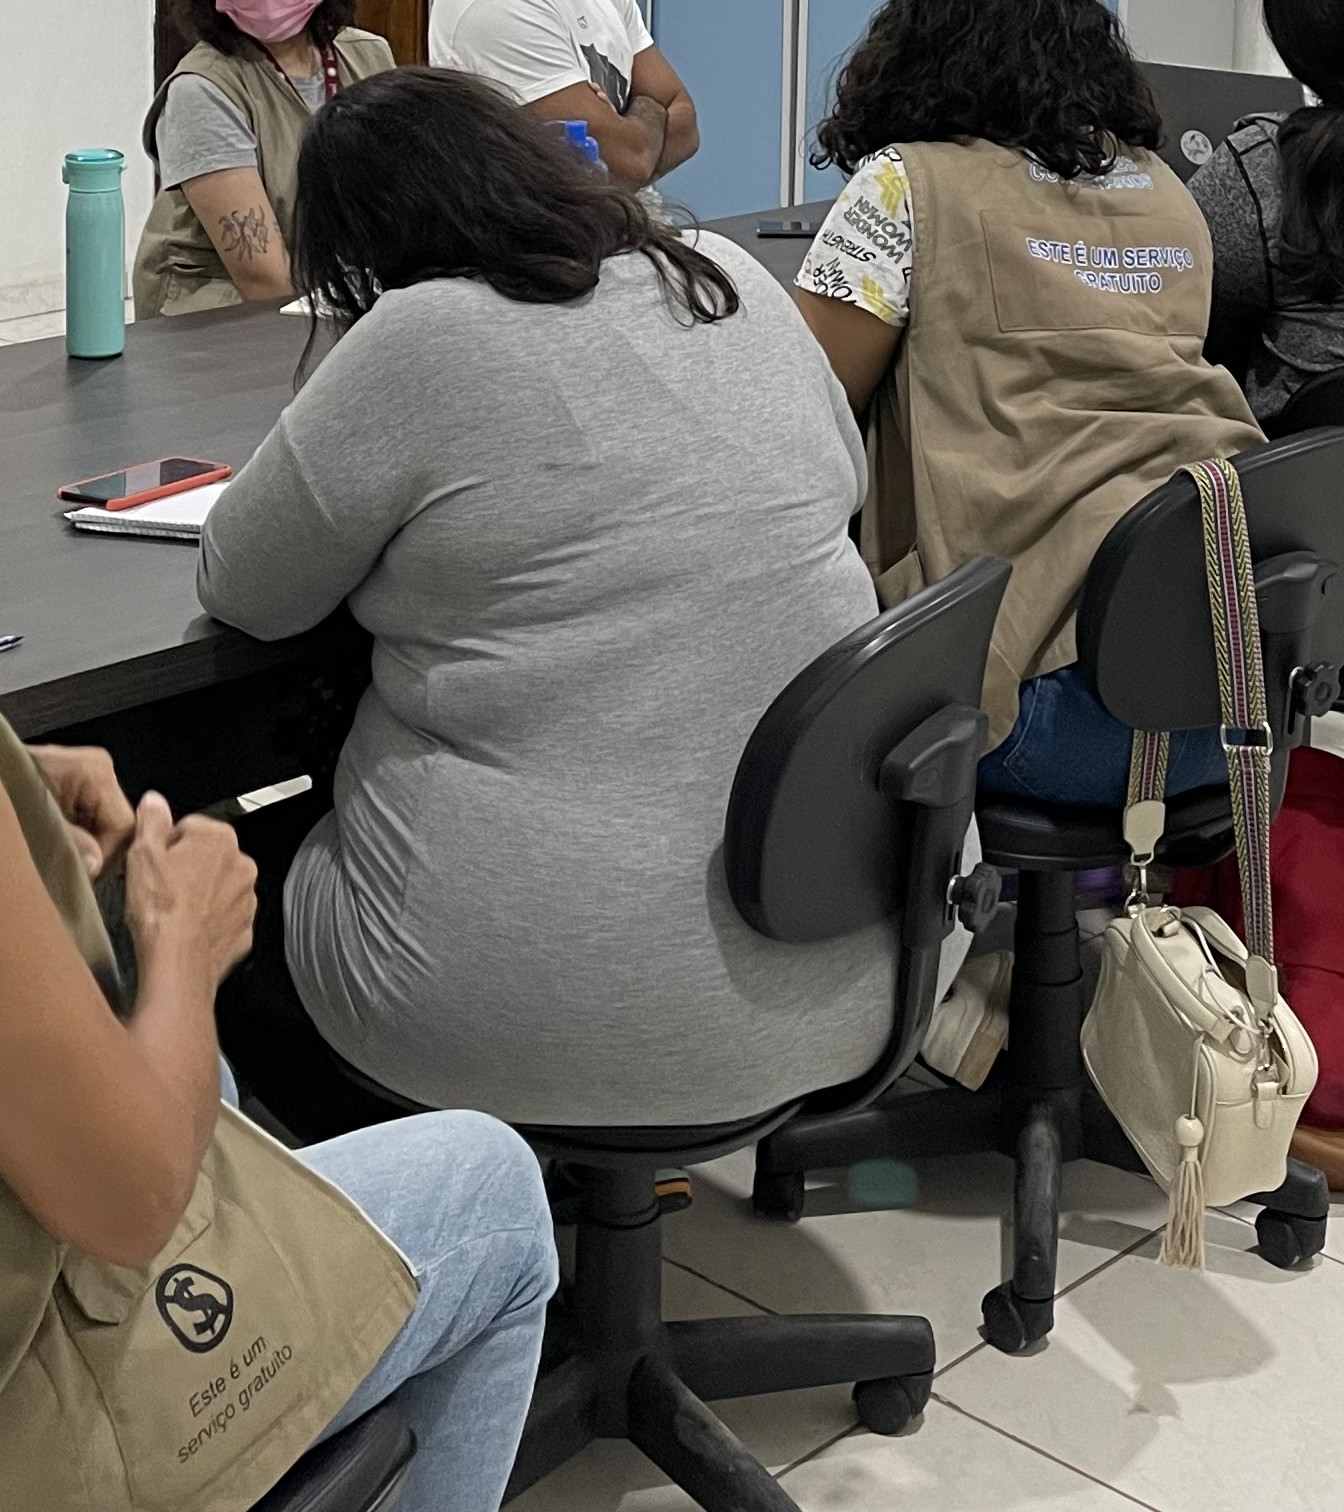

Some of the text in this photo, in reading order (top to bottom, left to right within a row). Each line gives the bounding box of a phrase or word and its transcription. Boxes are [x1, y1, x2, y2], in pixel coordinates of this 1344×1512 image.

[822, 229, 877, 263] STRENGTH
[843, 206, 905, 265] WONDER
[853, 195, 913, 252] WOMAN
[1026, 238, 1193, 272] ESTE É UM SERVIÇO
[177, 1345, 293, 1464] serviço gratuito
[188, 1336, 267, 1418] Este é um
